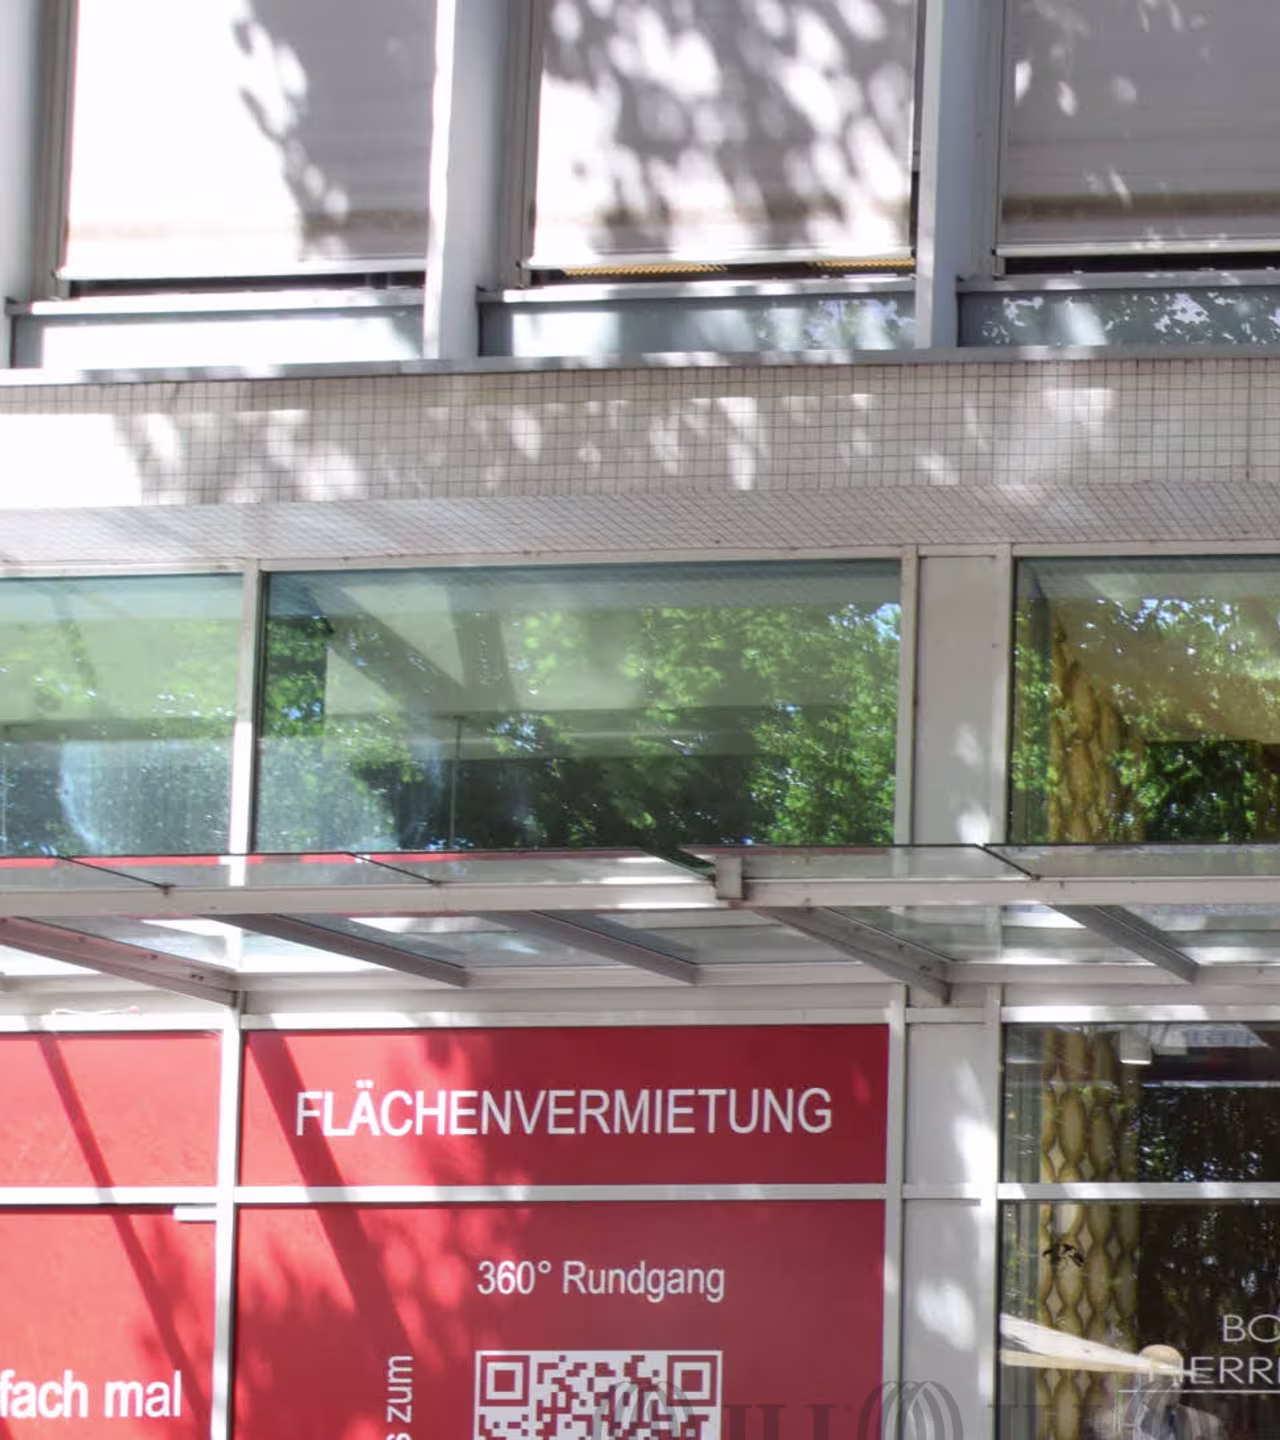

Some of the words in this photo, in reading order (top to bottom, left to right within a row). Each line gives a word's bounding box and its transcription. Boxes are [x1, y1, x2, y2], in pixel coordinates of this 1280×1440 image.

[295, 1079, 834, 1137] FLÄCHENVERMIETUNG
[476, 1260, 553, 1296] 360°
[562, 1260, 726, 1303] Rundgang
[0, 1369, 89, 1419] fach
[103, 1369, 183, 1418] mal
[386, 1355, 414, 1423] zum
